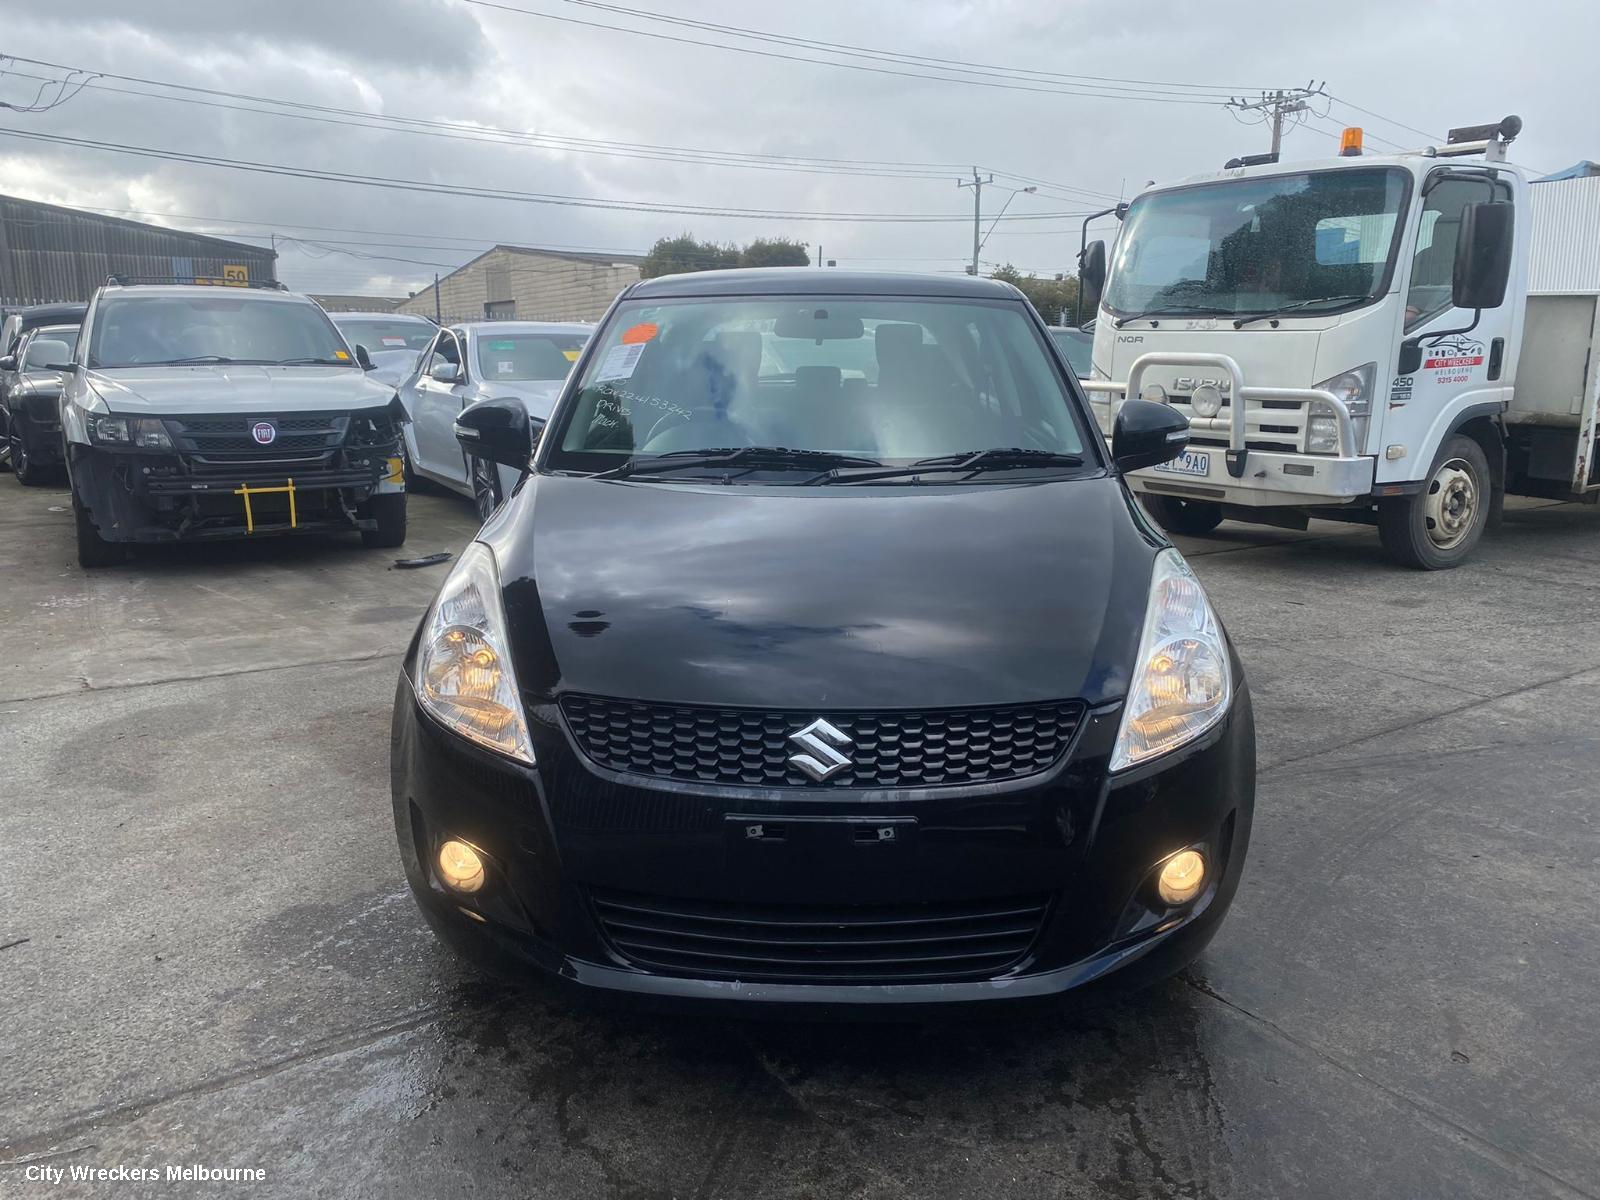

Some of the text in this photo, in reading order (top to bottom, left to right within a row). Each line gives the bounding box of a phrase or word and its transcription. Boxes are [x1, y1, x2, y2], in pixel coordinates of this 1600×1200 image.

[226, 270, 246, 283] 50
[1434, 358, 1475, 367] CITY WRECKERS
[1434, 367, 1473, 375] MELBOURNE
[1392, 377, 1414, 387] 450
[1453, 375, 1469, 383] 4000
